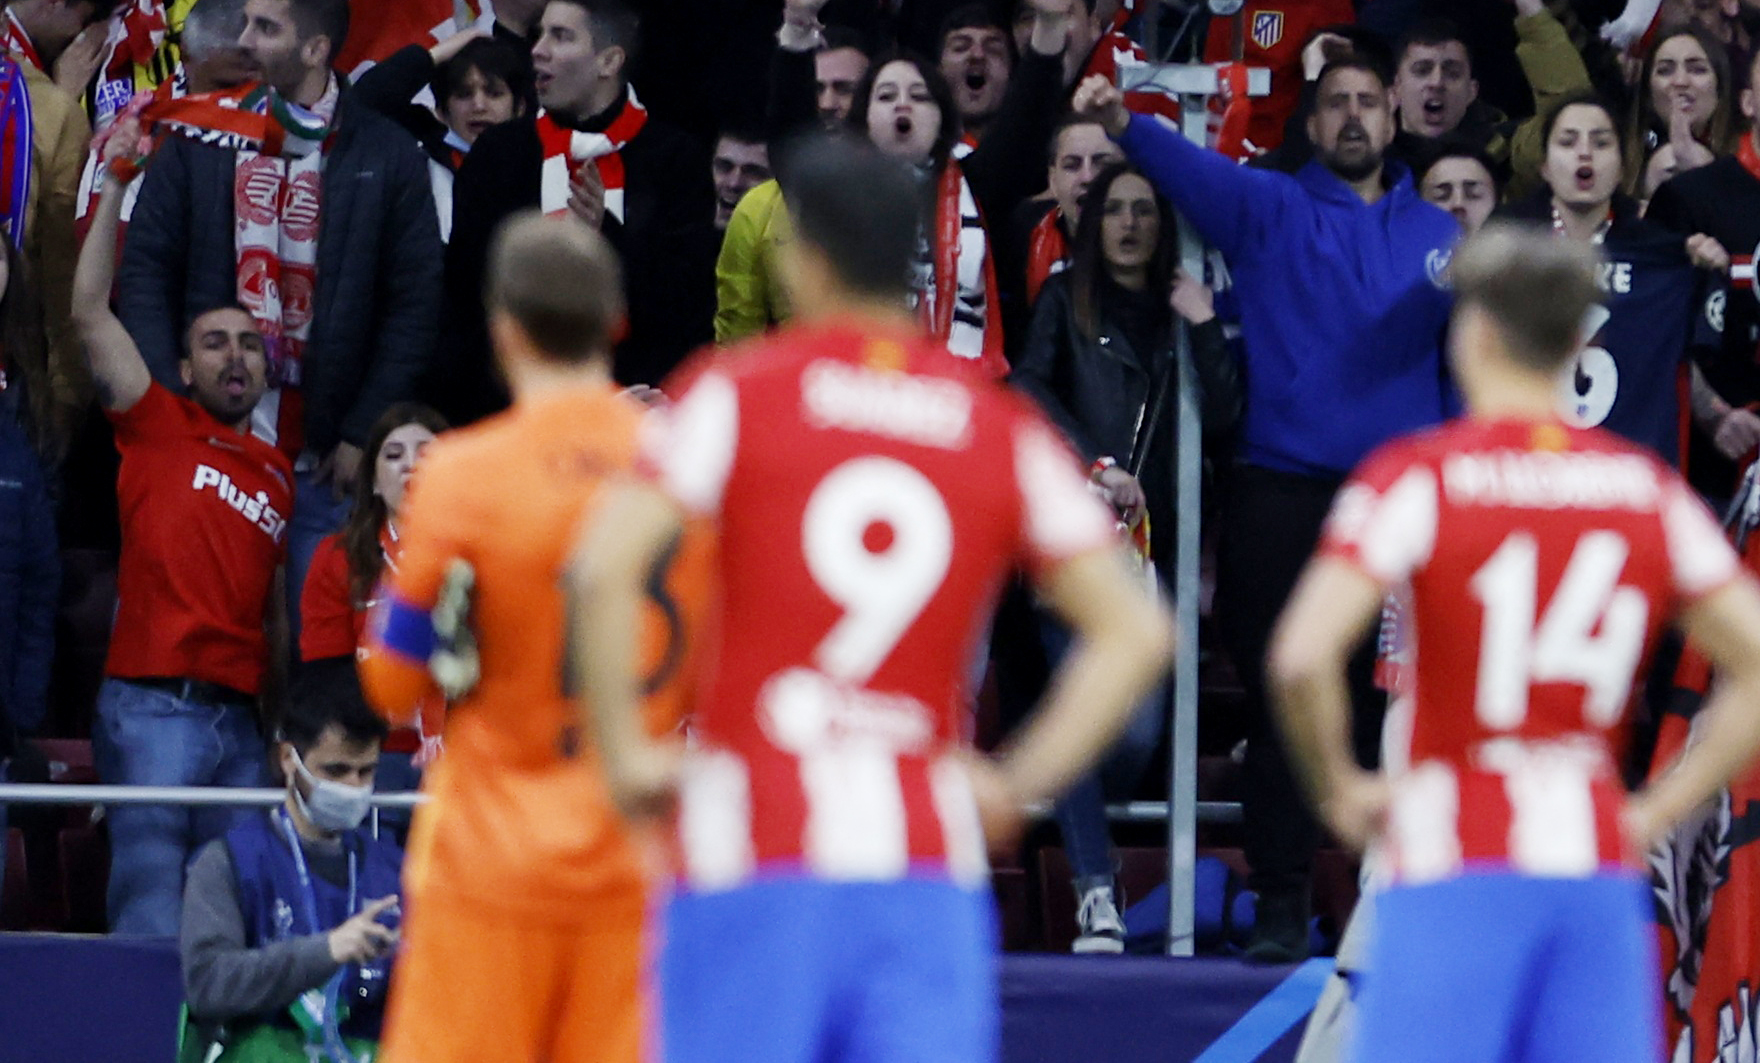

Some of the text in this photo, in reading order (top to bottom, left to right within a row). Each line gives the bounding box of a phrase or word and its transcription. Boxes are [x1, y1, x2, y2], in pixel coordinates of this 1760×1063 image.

[1557, 303, 1621, 431] 6
[803, 453, 956, 689] 9
[1466, 525, 1650, 733] 14
